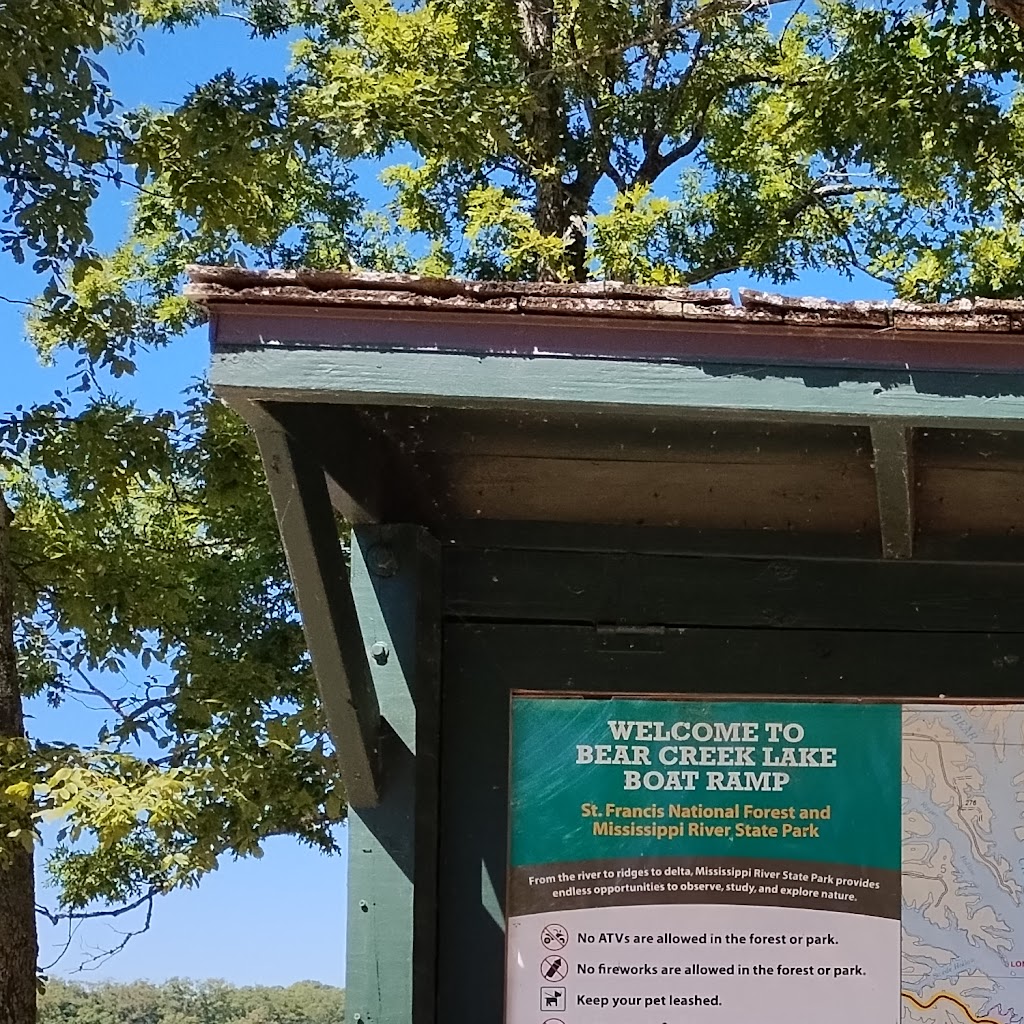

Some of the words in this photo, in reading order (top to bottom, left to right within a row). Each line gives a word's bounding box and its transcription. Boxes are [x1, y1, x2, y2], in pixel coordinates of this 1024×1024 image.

[607, 720, 759, 743] WELCOME
[767, 722, 805, 744] TO
[576, 745, 652, 766] BEAR
[659, 746, 756, 767] CREEK
[762, 747, 837, 768] LAKE
[624, 770, 700, 791] BOAT
[706, 771, 790, 792] RAMP
[581, 803, 603, 817] St.
[606, 803, 665, 818] Francis
[668, 804, 739, 819] National
[744, 805, 796, 819] Forest
[799, 805, 830, 820] and
[593, 821, 685, 841] Mississippi
[688, 822, 731, 838] River
[735, 822, 778, 838] State
[782, 823, 820, 839] Park
[528, 876, 556, 885] From
[558, 873, 576, 882] the
[577, 871, 601, 881] river
[603, 869, 615, 879] to
[616, 867, 649, 880] ridges
[651, 867, 663, 876] to
[664, 866, 694, 878] delta,
[695, 866, 751, 879] Mississippi
[753, 869, 781, 879] River
[782, 871, 809, 882] State
[811, 874, 834, 884] Park
[836, 876, 880, 890] provides
[552, 886, 592, 897] endless
[594, 882, 665, 896] opportunities
[666, 882, 678, 891] to
[680, 882, 724, 892] observe,
[726, 882, 757, 894] study,
[759, 884, 778, 894] and
[780, 886, 819, 898] explore
[821, 891, 857, 901] nature.
[578, 933, 595, 943] No
[598, 933, 630, 943] ATVs
[657, 933, 707, 944] allowed
[710, 933, 722, 944] in
[725, 933, 746, 944] the
[749, 933, 786, 944] forest
[790, 936, 803, 944] or
[806, 934, 838, 947] park.
[577, 964, 595, 974] No
[598, 963, 658, 975] fireworks
[661, 967, 681, 975] are
[684, 964, 734, 975] allowed
[738, 964, 749, 975] in
[753, 964, 774, 975] the
[777, 964, 814, 975] forest
[834, 965, 866, 978] park.
[577, 995, 609, 1008] Keep
[612, 998, 642, 1008] your
[645, 996, 666, 1008] pet
[670, 995, 722, 1006] leashed.
